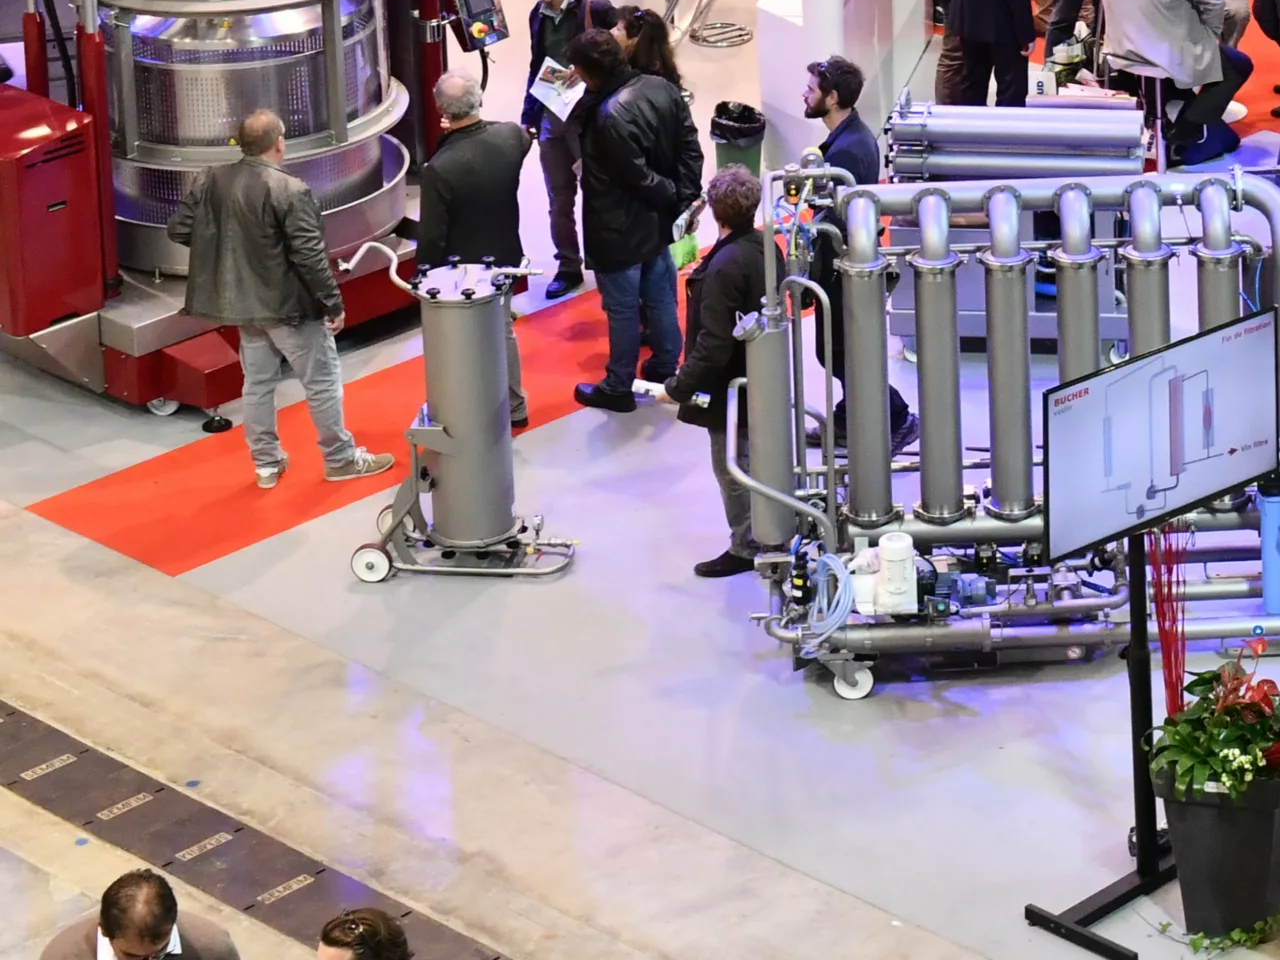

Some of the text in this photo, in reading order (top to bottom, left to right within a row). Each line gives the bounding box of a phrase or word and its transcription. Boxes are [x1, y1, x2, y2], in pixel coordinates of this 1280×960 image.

[1221, 319, 1272, 344] Fin de filtration
[1054, 387, 1090, 408] BUCHER
[1240, 443, 1252, 453] Vin
